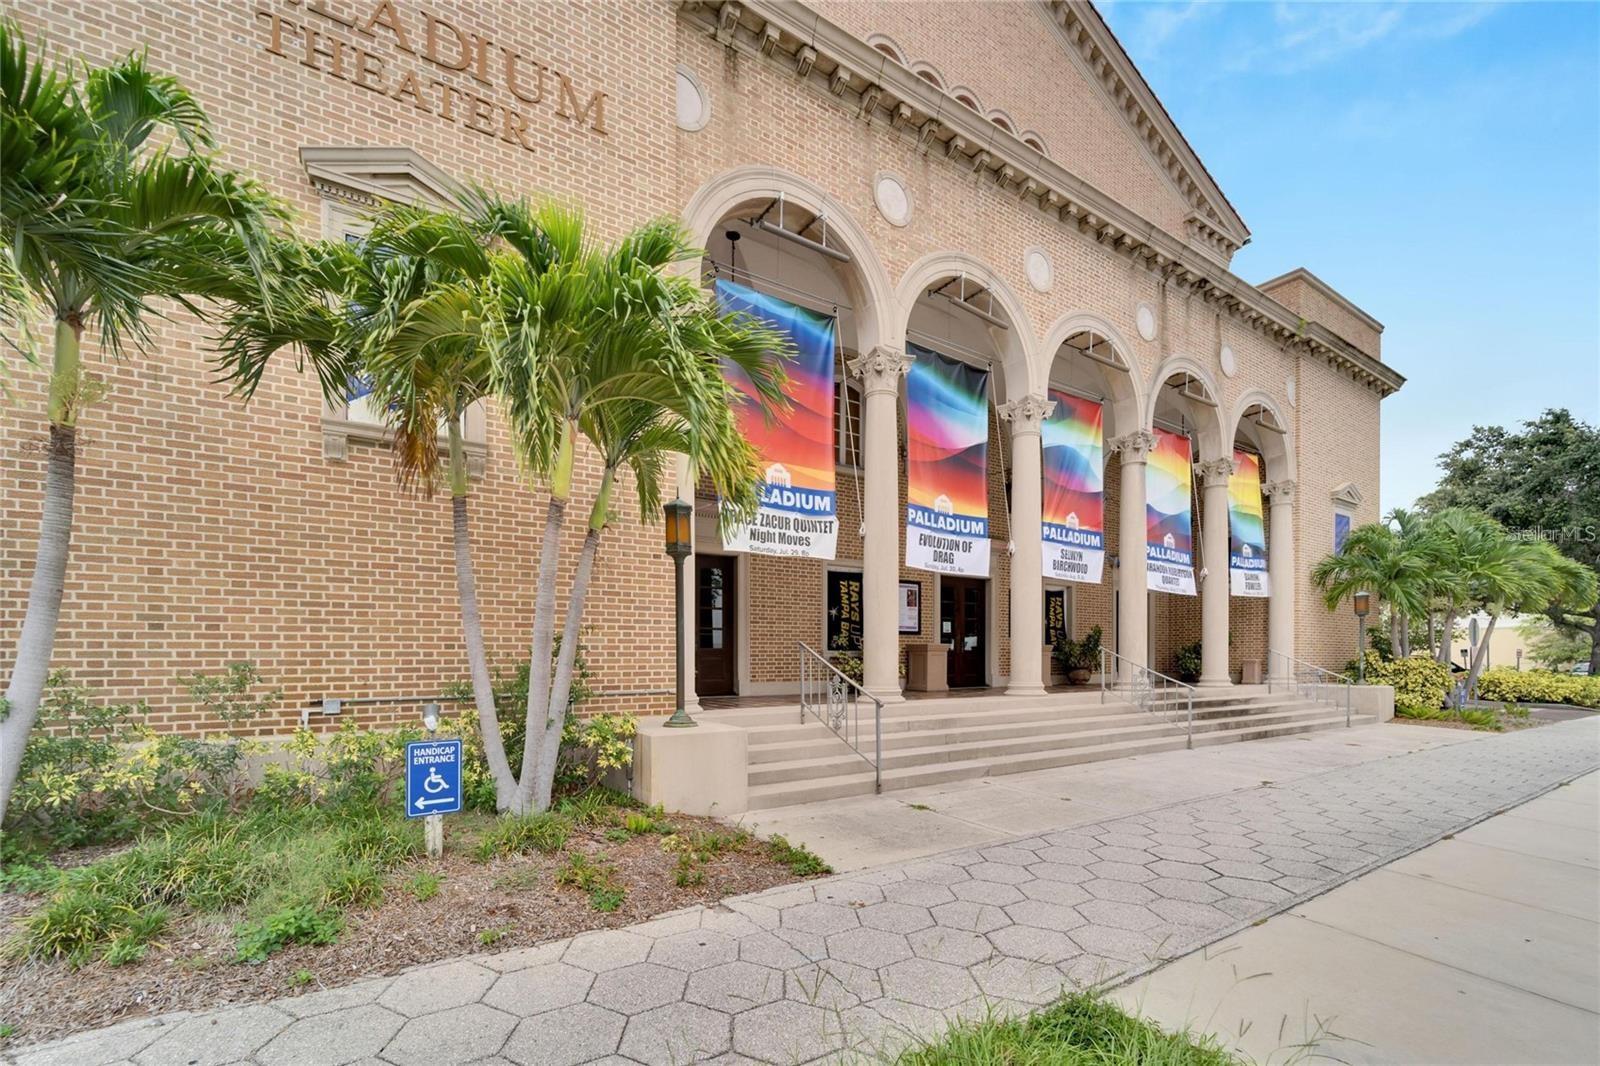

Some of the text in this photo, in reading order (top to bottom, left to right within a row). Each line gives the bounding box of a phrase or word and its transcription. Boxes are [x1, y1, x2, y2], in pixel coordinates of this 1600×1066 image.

[255, 11, 535, 152] THEATER
[760, 513, 791, 531] ZACUR
[793, 518, 834, 534] QUINTET
[907, 508, 985, 535] PALLADIUM
[749, 528, 811, 547] Night Moves
[918, 533, 973, 553] EVOLUTION OF
[1042, 526, 1101, 547] PALLADIUM
[933, 550, 955, 565] DRAG
[1147, 545, 1190, 565] PALLADIUM
[1052, 559, 1089, 575] BIRCHWOOD
[849, 581, 860, 622] RAYS
[838, 580, 850, 646] TAMPA BAY
[413, 746, 456, 757] HANDICAP
[413, 754, 456, 765] ENTRANCE
